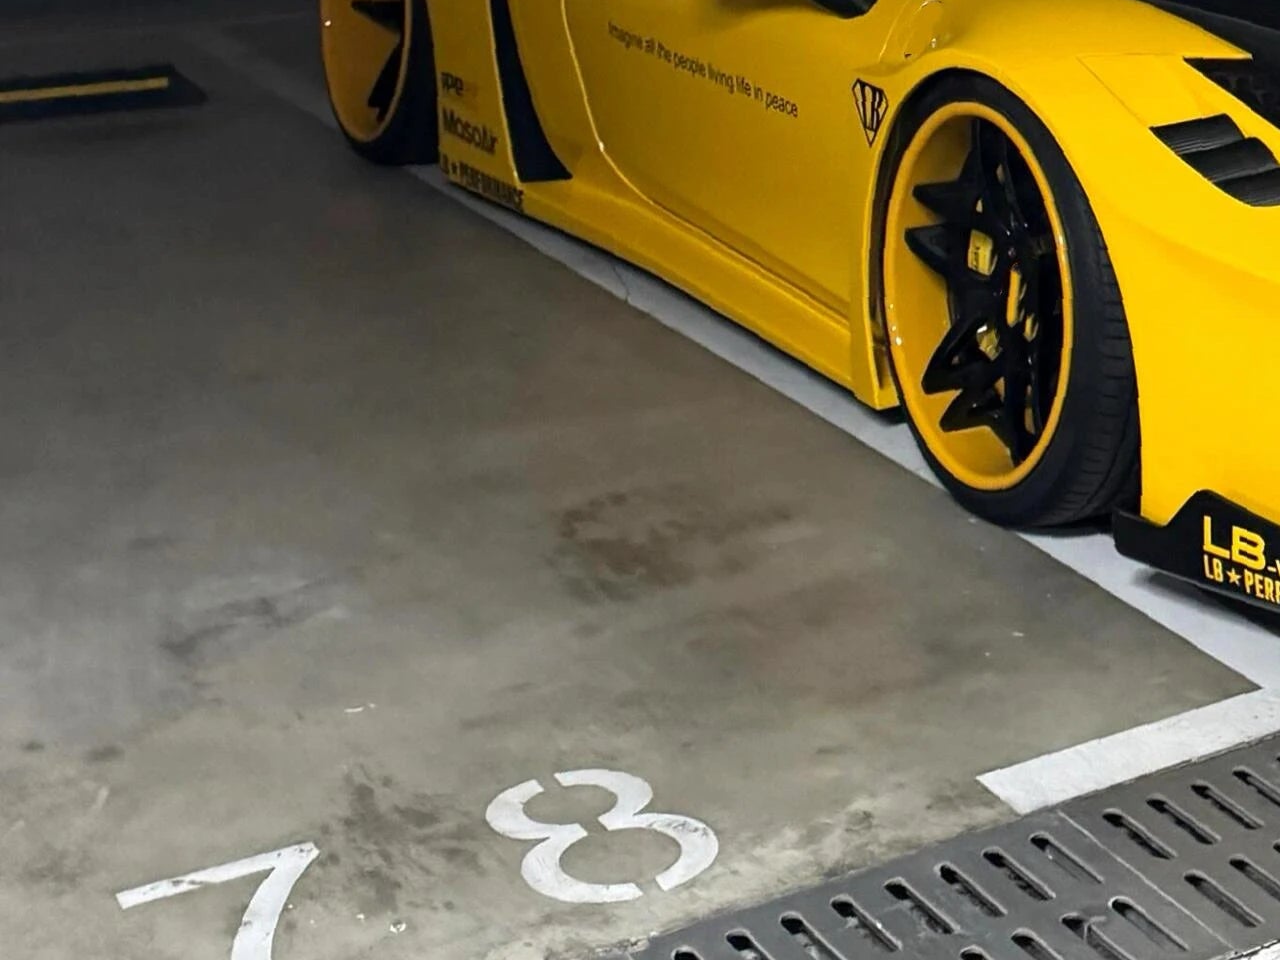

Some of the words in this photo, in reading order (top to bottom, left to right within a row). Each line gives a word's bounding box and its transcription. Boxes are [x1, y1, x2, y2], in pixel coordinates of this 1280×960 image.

[607, 20, 643, 49] Imagine
[656, 40, 673, 63] the
[673, 51, 706, 77] people
[707, 62, 735, 94] living
[736, 75, 752, 97] life
[754, 85, 763, 101] in
[765, 91, 798, 118] peace
[1203, 554, 1223, 583] LB
